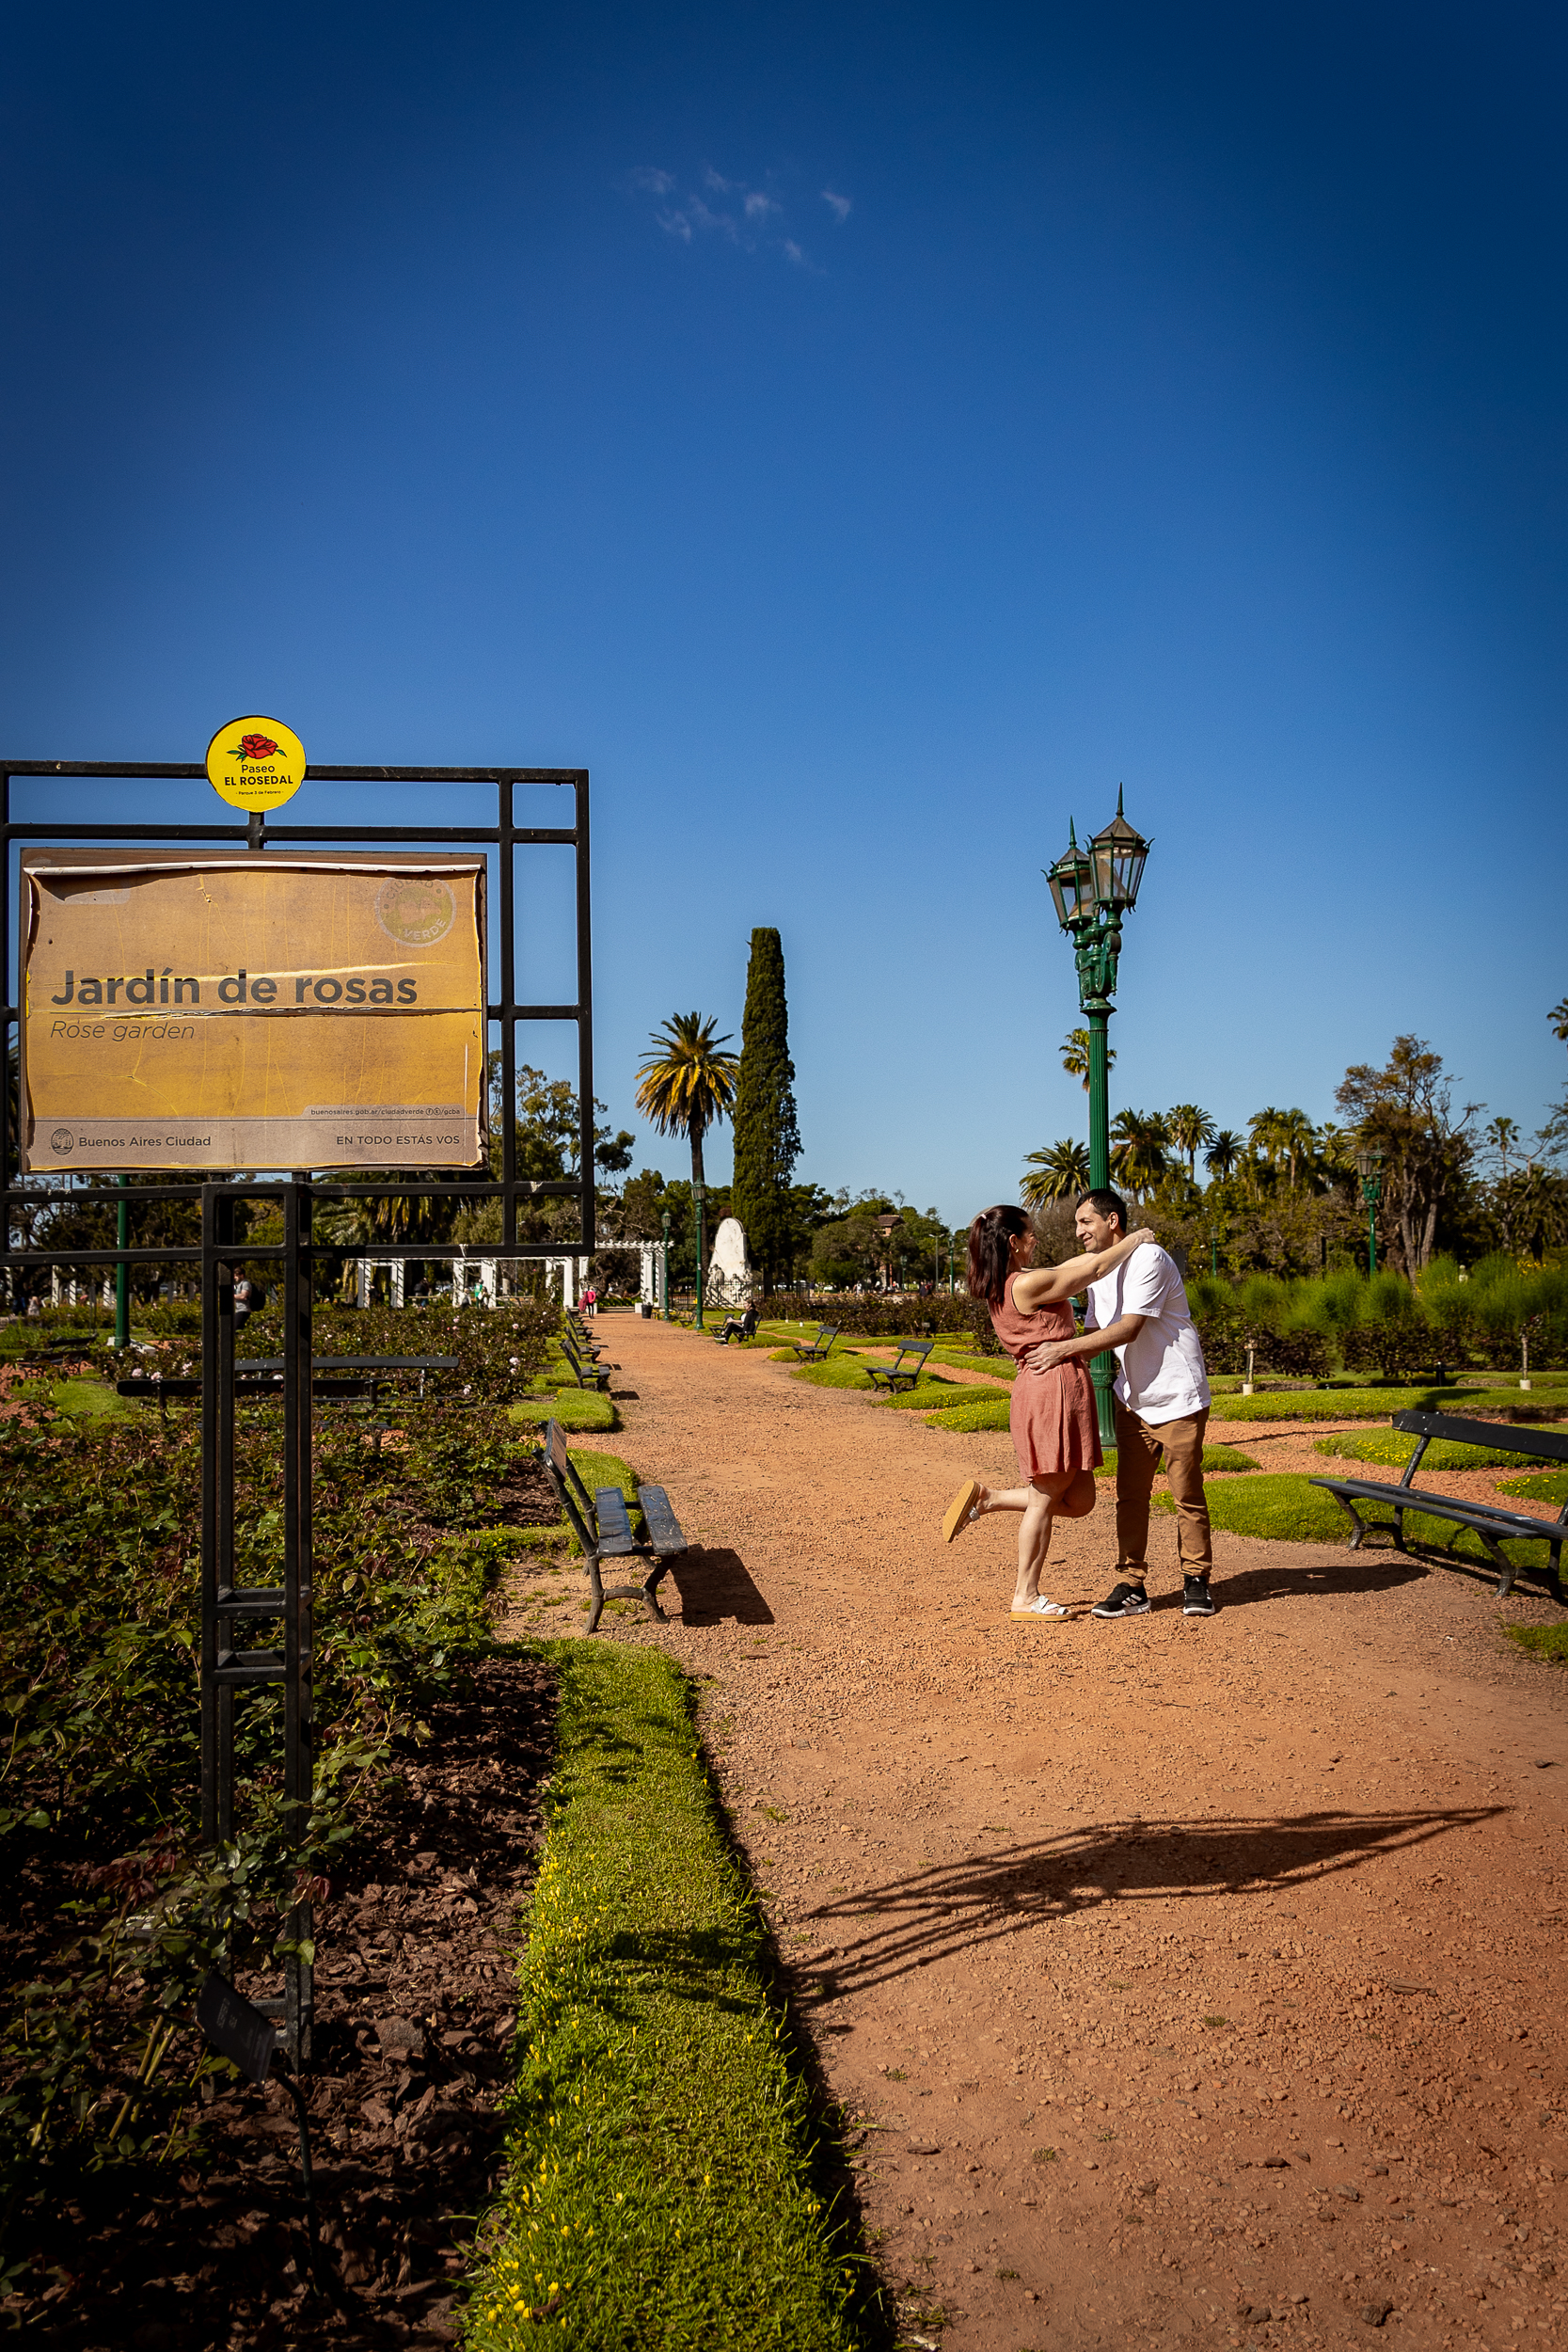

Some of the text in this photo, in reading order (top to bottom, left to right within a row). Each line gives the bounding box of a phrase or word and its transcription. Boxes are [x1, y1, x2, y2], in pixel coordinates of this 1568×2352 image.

[241, 764, 275, 773] Paseo
[224, 774, 293, 786] EL ROSEDAL
[404, 918, 447, 941] VERDE
[50, 967, 418, 1006] Jardín de rosas
[50, 1021, 195, 1041] Rose garden
[310, 1108, 424, 1117] buenosaires.gob.ar/ciudadverde
[78, 1136, 212, 1147] Buenos Aires Ciudad
[336, 1133, 460, 1145] EN TODO ESTÁS VOS
